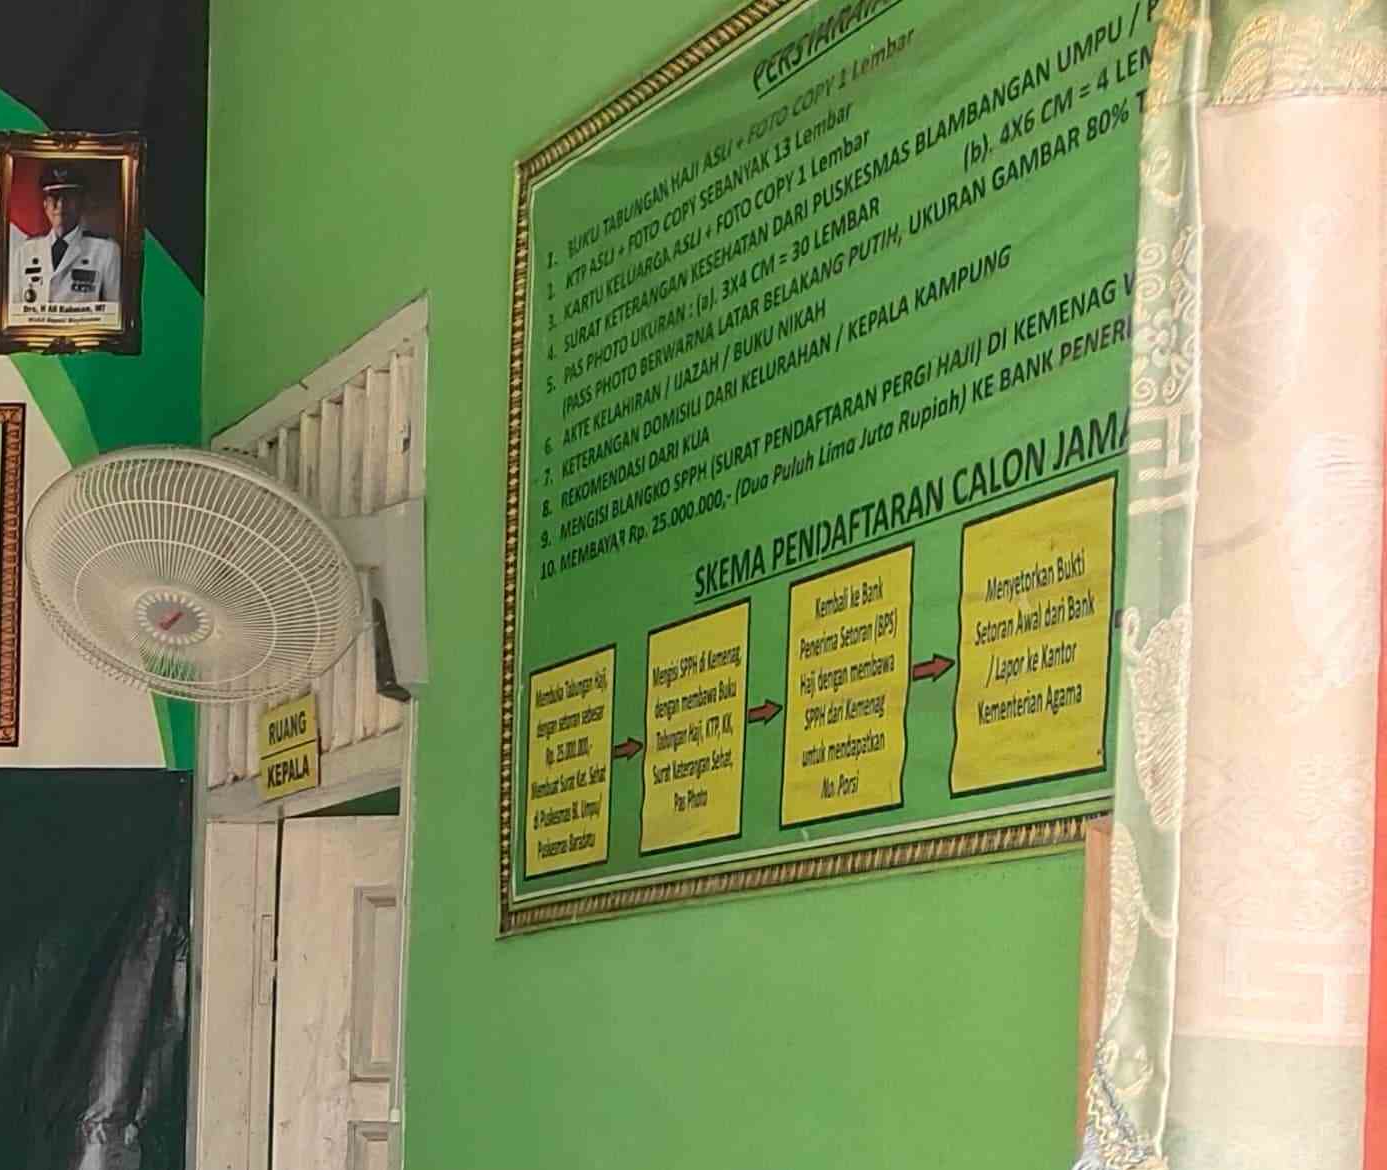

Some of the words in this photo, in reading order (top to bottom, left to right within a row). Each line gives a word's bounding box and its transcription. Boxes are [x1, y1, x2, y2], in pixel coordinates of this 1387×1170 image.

[563, 318, 603, 353] SURAT
[604, 272, 688, 330] KETERANGAN
[690, 222, 769, 281] KESEHATAN
[772, 203, 809, 238] DARI
[812, 140, 911, 215] PUSKESMAS
[915, 56, 1051, 157] BLAMBANGAN
[1056, 15, 1123, 74] UMPU
[909, 175, 988, 236] UKURAN
[991, 126, 1081, 191] GAMBAR
[562, 427, 640, 480] KETERANGAN
[643, 399, 702, 441] DOMISILI
[704, 376, 739, 413] DARI
[741, 332, 832, 394] KELURAHAN
[847, 295, 910, 345] KEPALA
[914, 244, 1013, 312] KAMPUNG
[764, 382, 878, 454] PENDAFTARAN
[882, 359, 932, 403] PERGI
[1013, 278, 1118, 346] KEMENAG
[560, 455, 647, 510] REKOMENDASI
[648, 442, 679, 471] DARI
[682, 426, 711, 454] KUA
[694, 544, 767, 599] SKEMA
[772, 475, 944, 572] PENDAFTARAN
[951, 438, 1047, 507] CALON
[985, 560, 1056, 603] Menyetorkan
[1057, 546, 1086, 583] Bukti
[974, 614, 1014, 647] Setoran
[1015, 602, 1042, 636] Awal
[1044, 595, 1066, 628] dari
[1068, 588, 1096, 622] Bank
[995, 656, 1025, 685] Lapor
[1026, 650, 1040, 674] ke
[1041, 641, 1077, 670] Kantor
[268, 710, 308, 746] RUANG
[977, 690, 1044, 727] Kementerian
[1045, 683, 1083, 715] Agama
[267, 754, 311, 790] KEPALA
